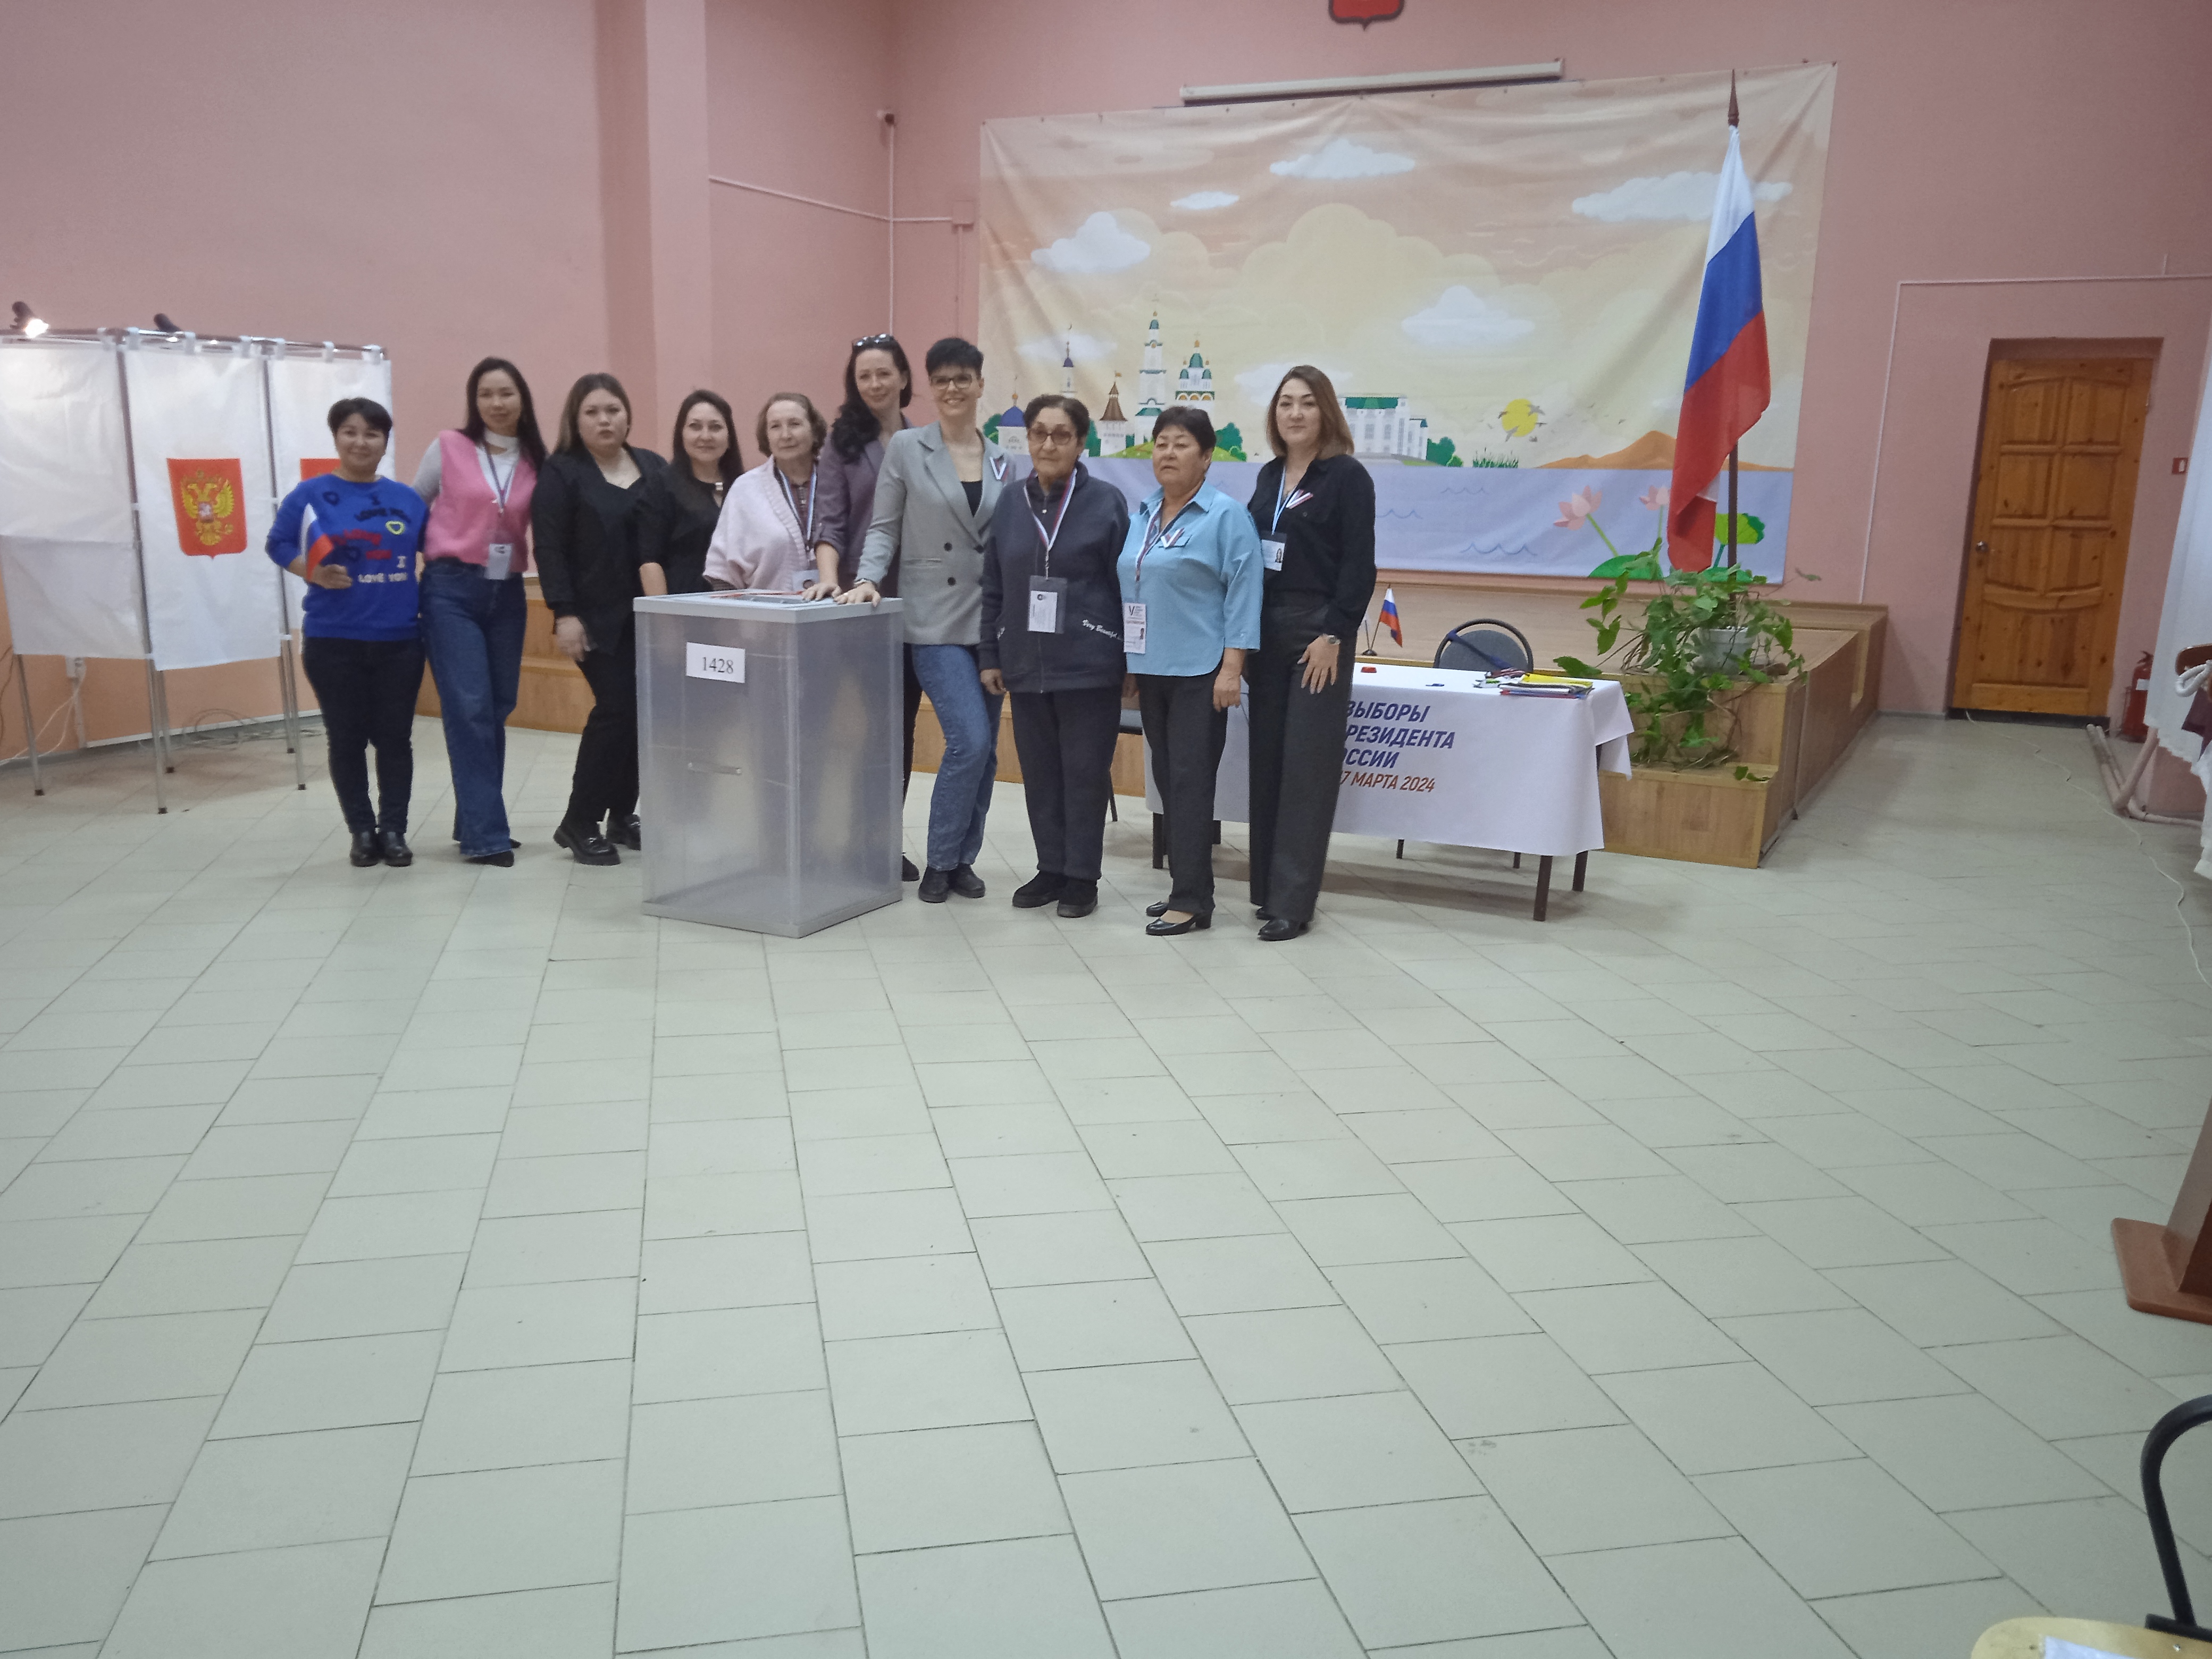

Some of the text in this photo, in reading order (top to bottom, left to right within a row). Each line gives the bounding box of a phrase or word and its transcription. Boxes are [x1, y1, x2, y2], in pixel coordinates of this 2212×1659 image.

[702, 657, 733, 674] 1428
[1346, 724, 1456, 749] РЕЗИДЕНТА
[1351, 772, 1399, 790] МАРТА
[1400, 776, 1435, 793] 2024
